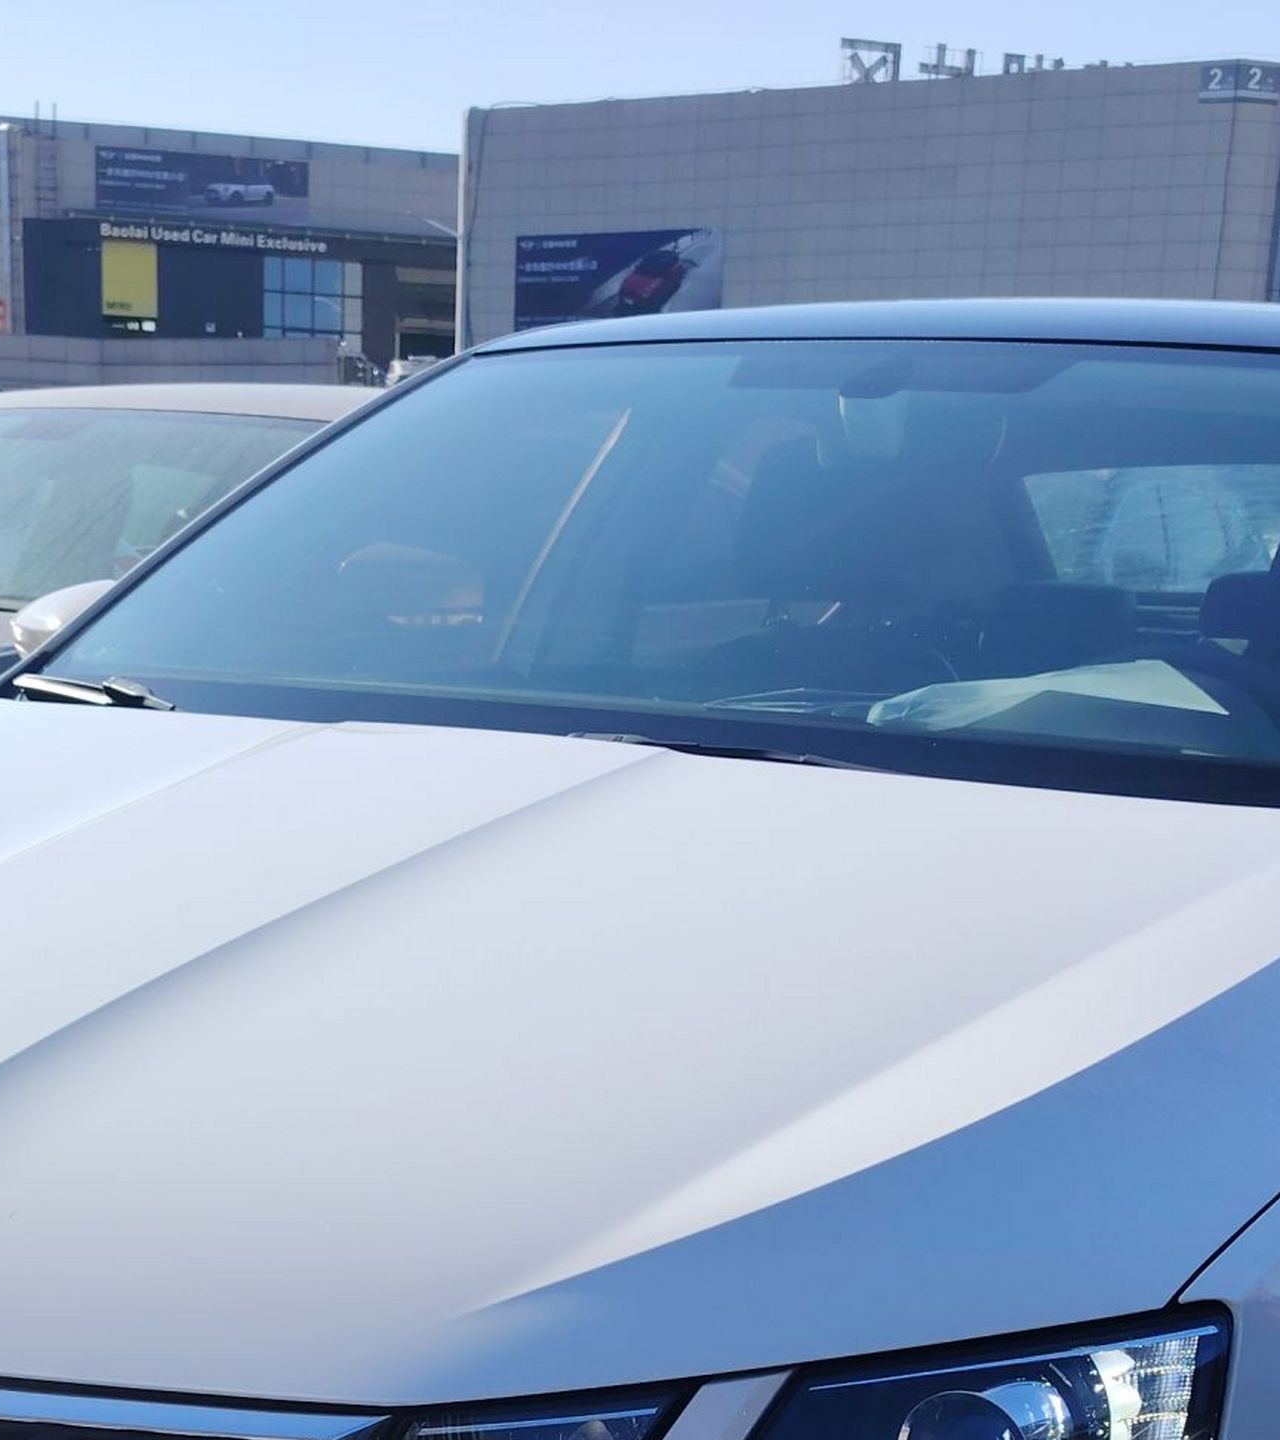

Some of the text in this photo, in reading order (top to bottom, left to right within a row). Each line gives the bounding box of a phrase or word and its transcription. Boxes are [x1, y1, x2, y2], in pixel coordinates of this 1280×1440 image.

[150, 224, 190, 243] Used
[192, 229, 218, 245] Car
[220, 231, 254, 248] Mini
[257, 234, 328, 253] Exclusive
